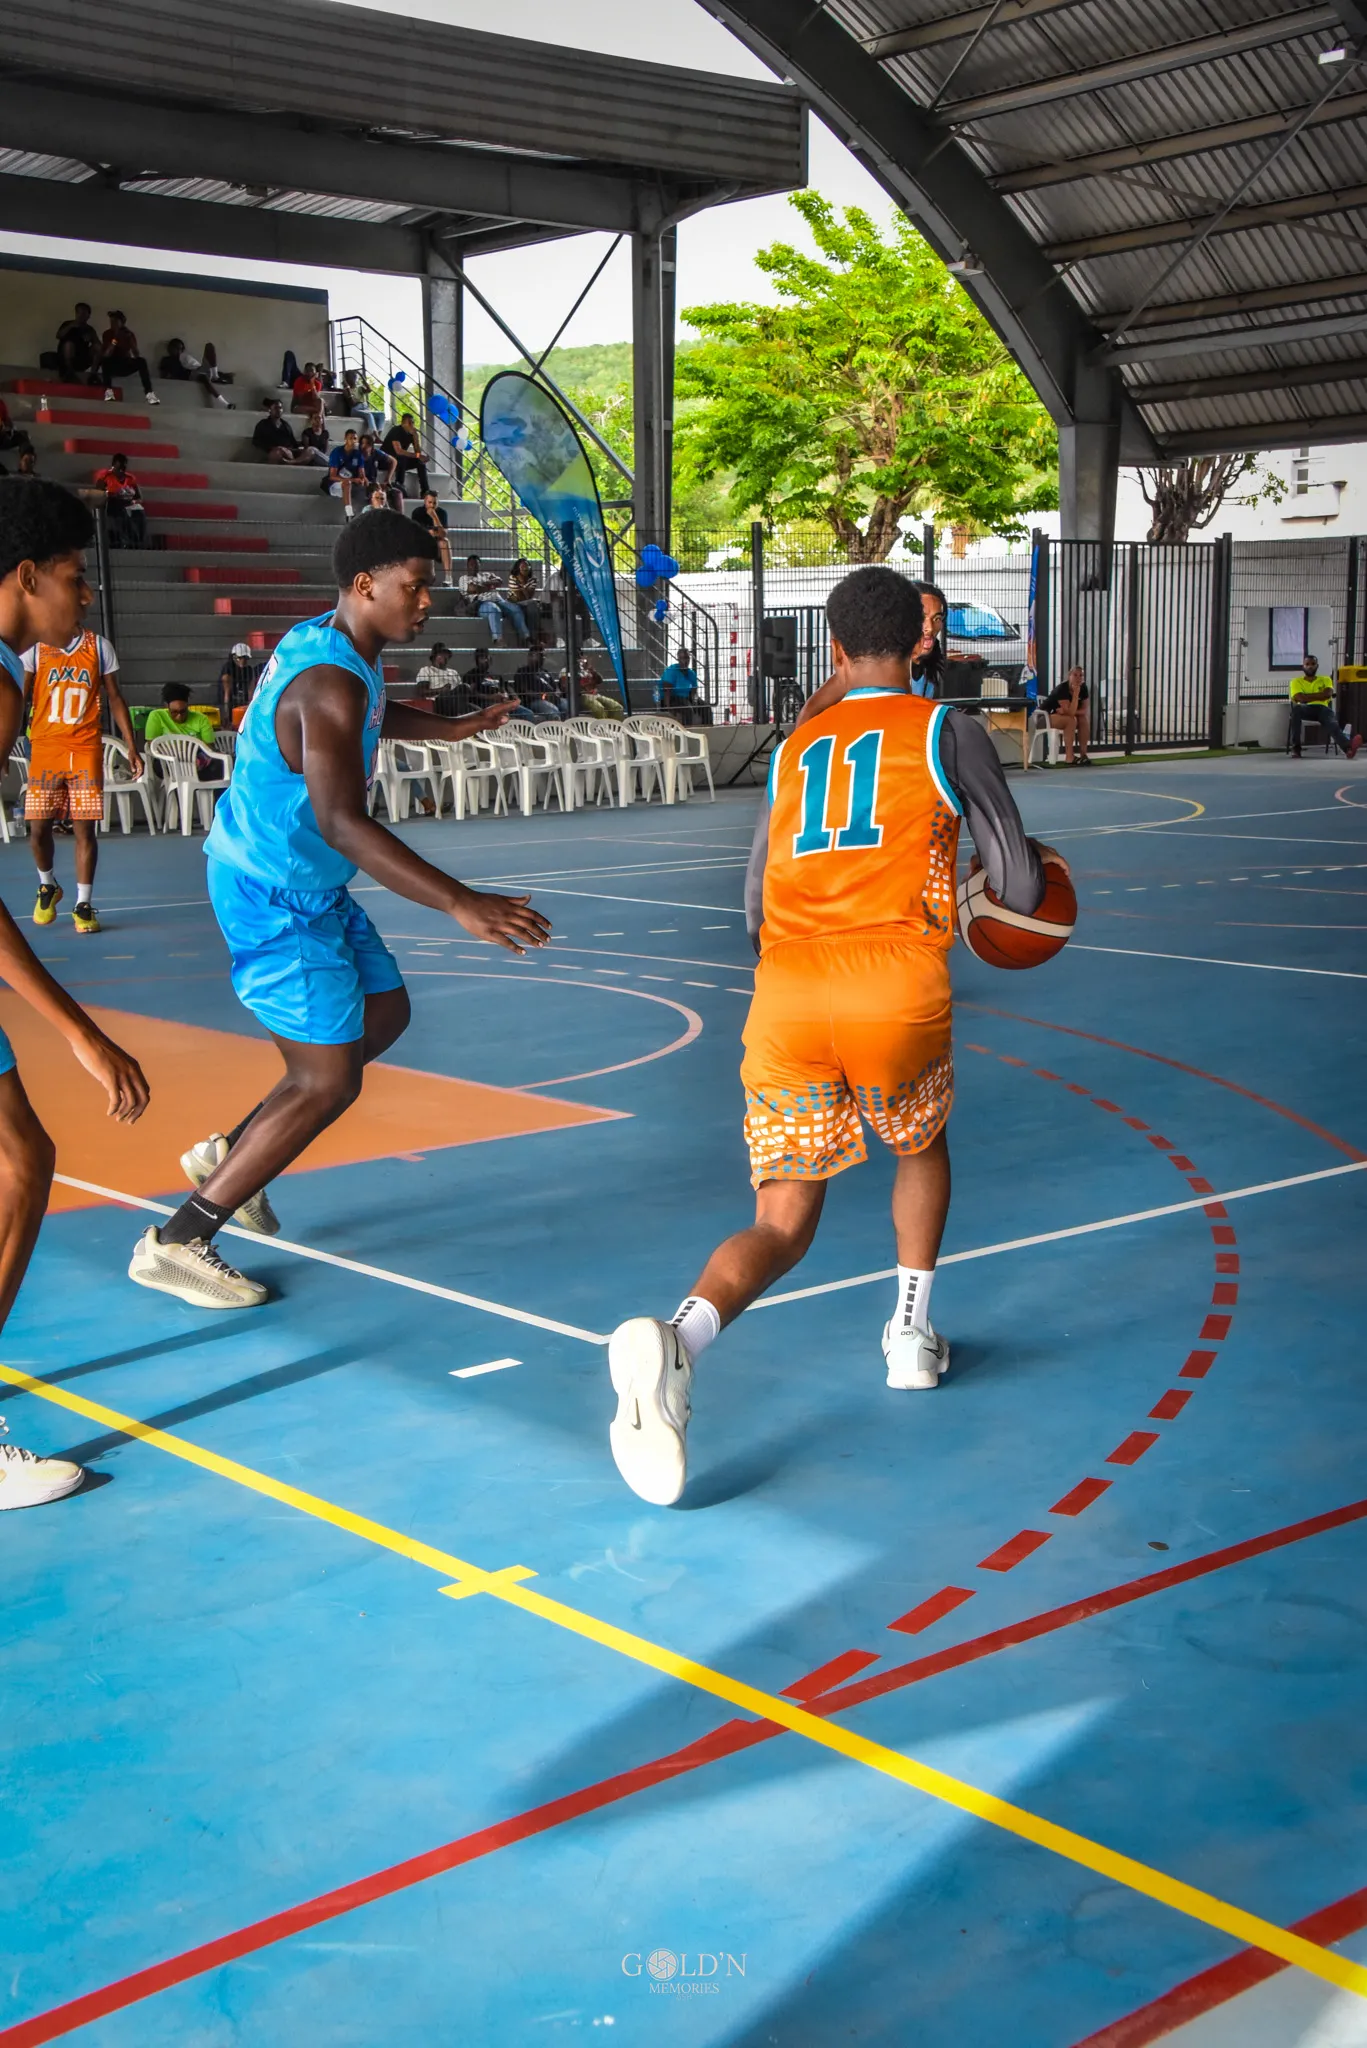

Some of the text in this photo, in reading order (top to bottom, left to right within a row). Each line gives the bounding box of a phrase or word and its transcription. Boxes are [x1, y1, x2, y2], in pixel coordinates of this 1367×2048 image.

[48, 666, 92, 688] AXA
[47, 686, 88, 725] 10
[792, 729, 885, 859] 11
